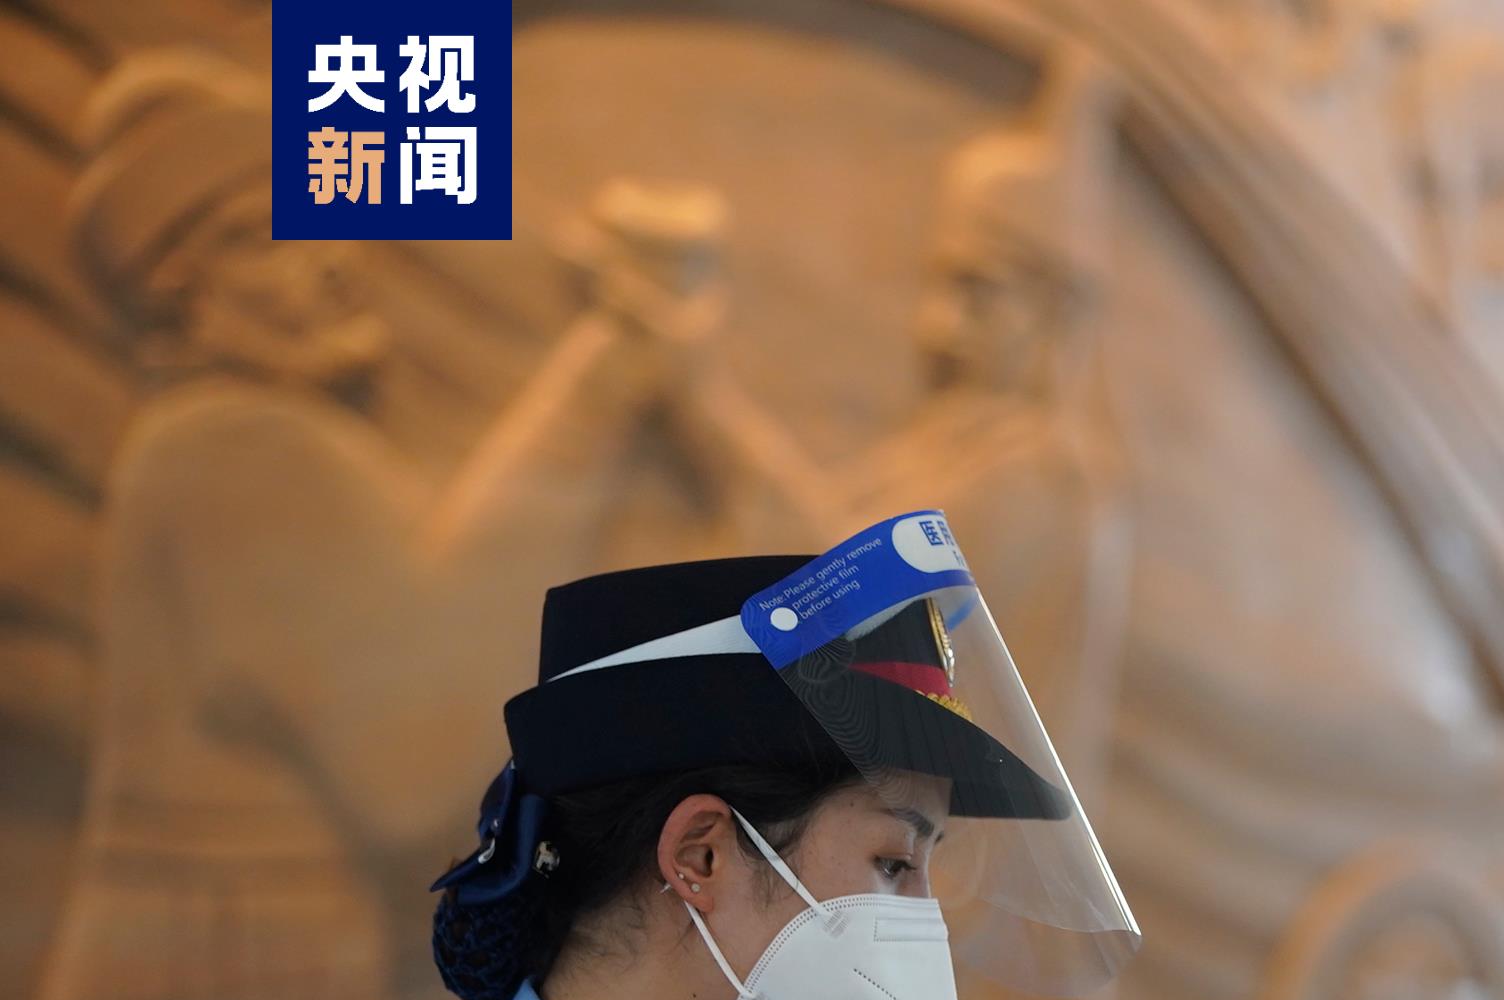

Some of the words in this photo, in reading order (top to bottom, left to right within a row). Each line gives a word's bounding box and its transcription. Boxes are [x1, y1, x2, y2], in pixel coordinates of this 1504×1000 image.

[816, 557, 846, 580] gently
[847, 538, 882, 561] remove
[792, 577, 839, 611] protective
[838, 564, 859, 580] film
[798, 596, 832, 620] before
[833, 580, 860, 600] using
